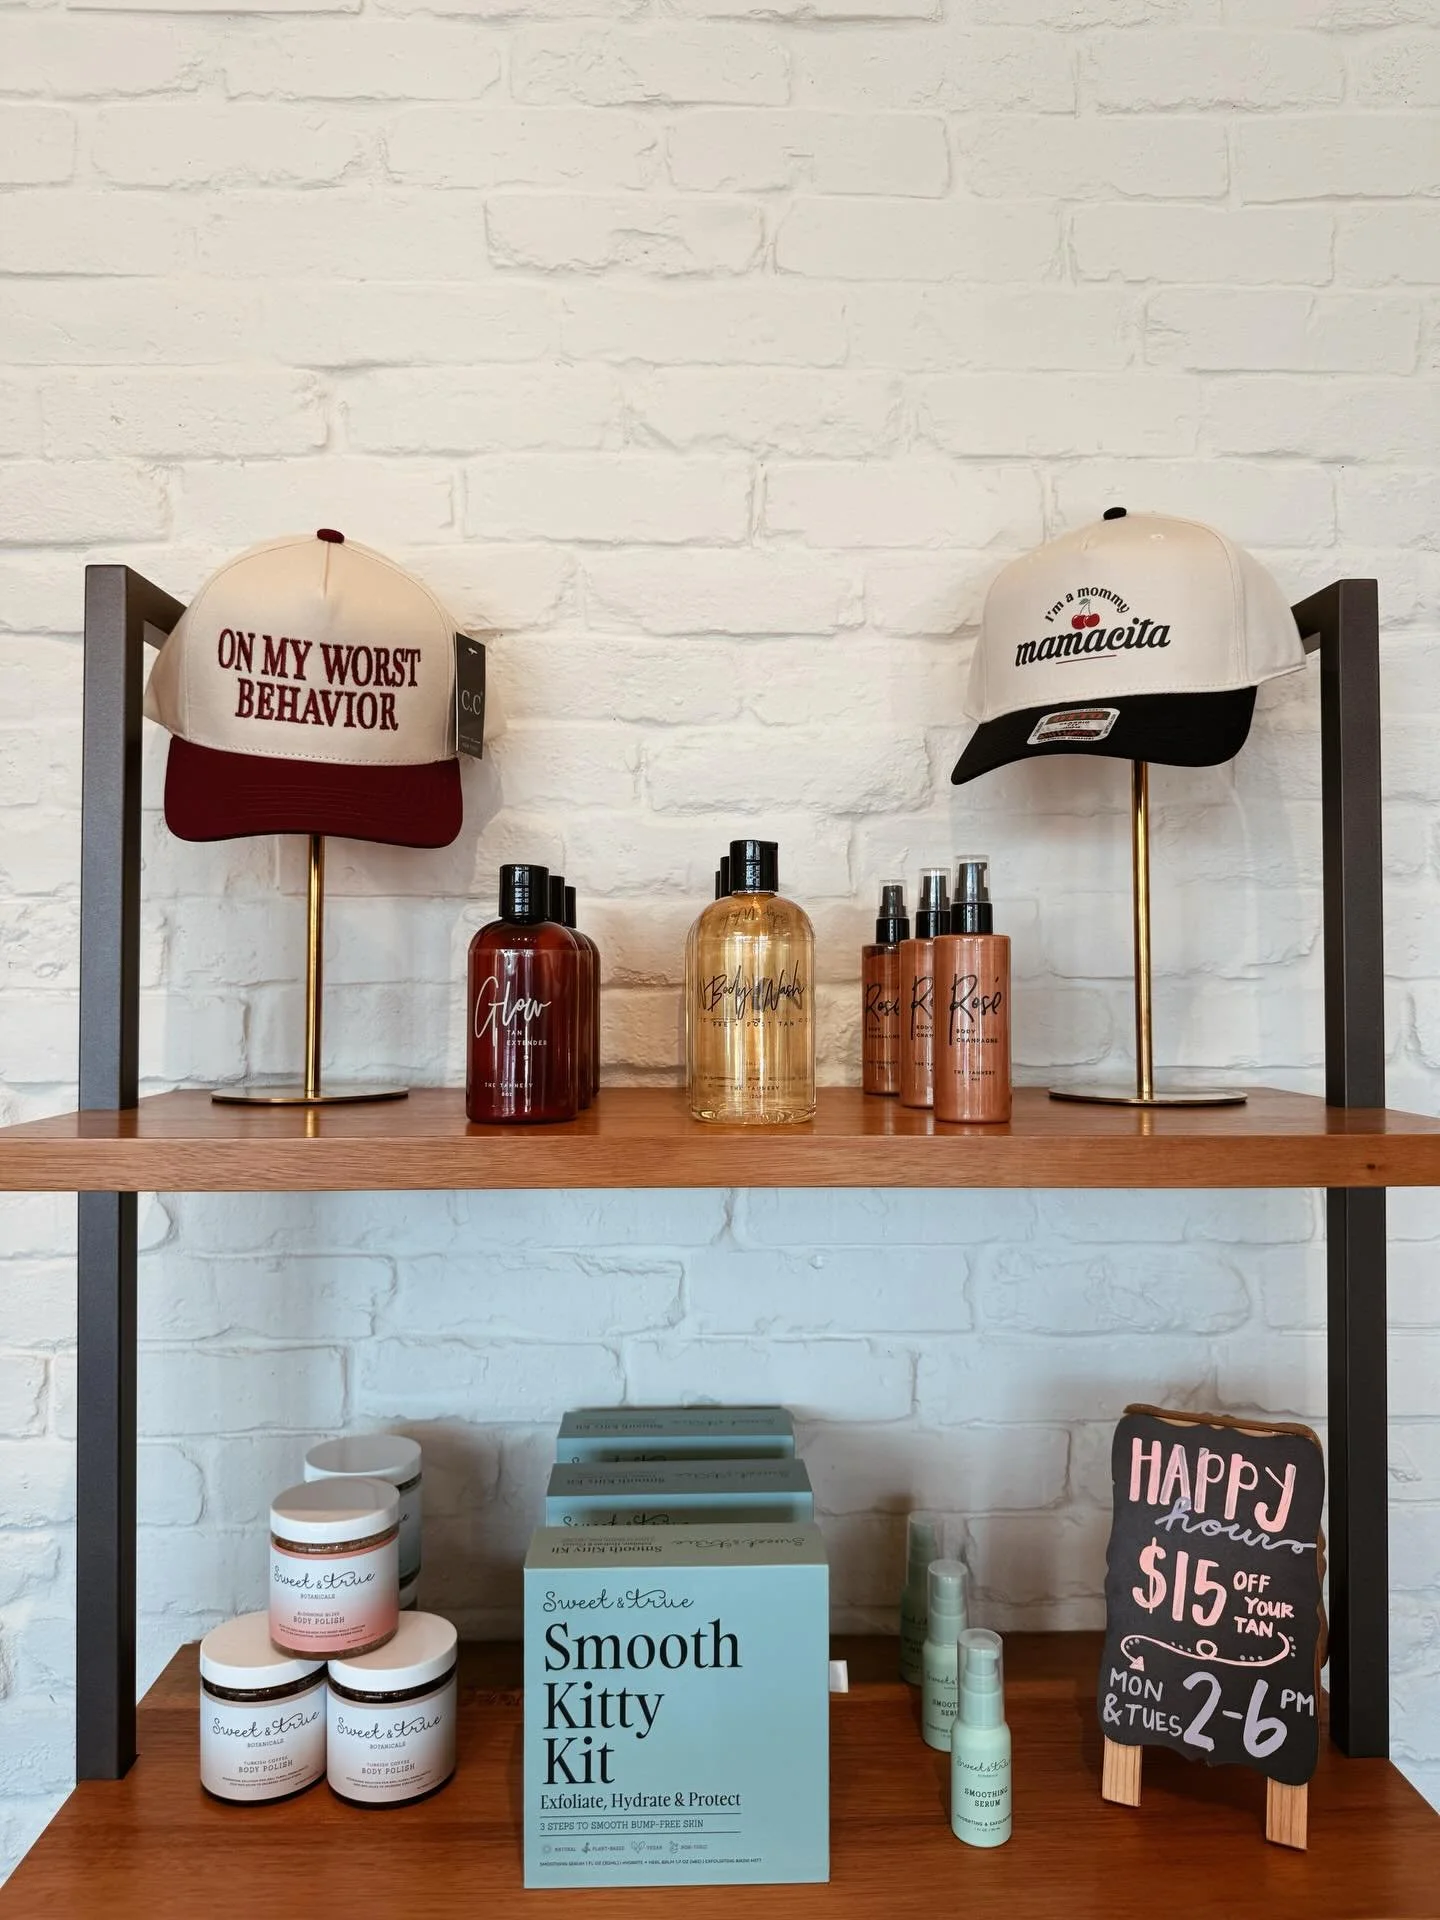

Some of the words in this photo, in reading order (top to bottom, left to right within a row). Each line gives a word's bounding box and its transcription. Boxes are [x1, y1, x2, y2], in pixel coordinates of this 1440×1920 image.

[1045, 600, 1064, 623] I'm
[1066, 592, 1075, 603] a
[1077, 587, 1130, 614] mommy
[1015, 617, 1171, 667] mamacita
[218, 628, 256, 671] ON
[261, 635, 313, 681] MY
[320, 643, 421, 688] WORST
[235, 677, 399, 731] BEHAVIOR
[703, 965, 753, 1020] Body
[762, 960, 805, 1012] Wash
[474, 976, 552, 1048] Glow
[949, 973, 1002, 1046] Rosé
[1129, 1437, 1297, 1532] HAPPY
[1154, 1496, 1317, 1554] hours
[551, 1546, 570, 1555] Kit
[574, 1545, 606, 1554] Kitty
[609, 1545, 663, 1554] Smooth
[274, 1565, 314, 1589] Sweet
[316, 1580, 322, 1589] &
[323, 1571, 375, 1589] true
[1132, 1537, 1228, 1627] $15
[1233, 1570, 1271, 1595] OFF
[543, 1588, 614, 1611] Sweet
[617, 1598, 625, 1609] &
[625, 1588, 694, 1610] true
[1244, 1595, 1296, 1619] YOUR
[293, 1615, 312, 1625] BODY
[315, 1616, 345, 1625] POLISH
[1233, 1615, 1275, 1639] TAN
[545, 1618, 743, 1672] Smooth
[1109, 1667, 1164, 1702] MON
[543, 1681, 665, 1739] Kitty
[1182, 1671, 1288, 1759] 2-6
[1280, 1688, 1316, 1718] PM
[212, 1717, 262, 1738] Sweet
[264, 1726, 271, 1736] &
[272, 1711, 320, 1736] true
[337, 1717, 385, 1740] Sweet
[386, 1730, 393, 1739] &
[394, 1715, 442, 1738] true
[238, 1766, 260, 1774] BODY
[263, 1759, 293, 1773] POLISH
[361, 1767, 382, 1775] BODY
[385, 1763, 415, 1775] POLISH
[543, 1736, 615, 1786] Kit
[540, 1793, 608, 1810] Exfoliate,
[611, 1792, 671, 1811] Hydrate
[675, 1791, 685, 1806] &
[689, 1791, 742, 1807] Protect
[964, 1786, 1008, 1798] SMOOTHING
[974, 1799, 1001, 1808] SERUM
[540, 1822, 545, 1830] 3
[547, 1821, 575, 1831] STEPS
[577, 1821, 589, 1830] TO
[591, 1820, 629, 1830] SMOOTH
[631, 1820, 681, 1829] BUMP-FREE
[683, 1819, 704, 1828] SKIN
